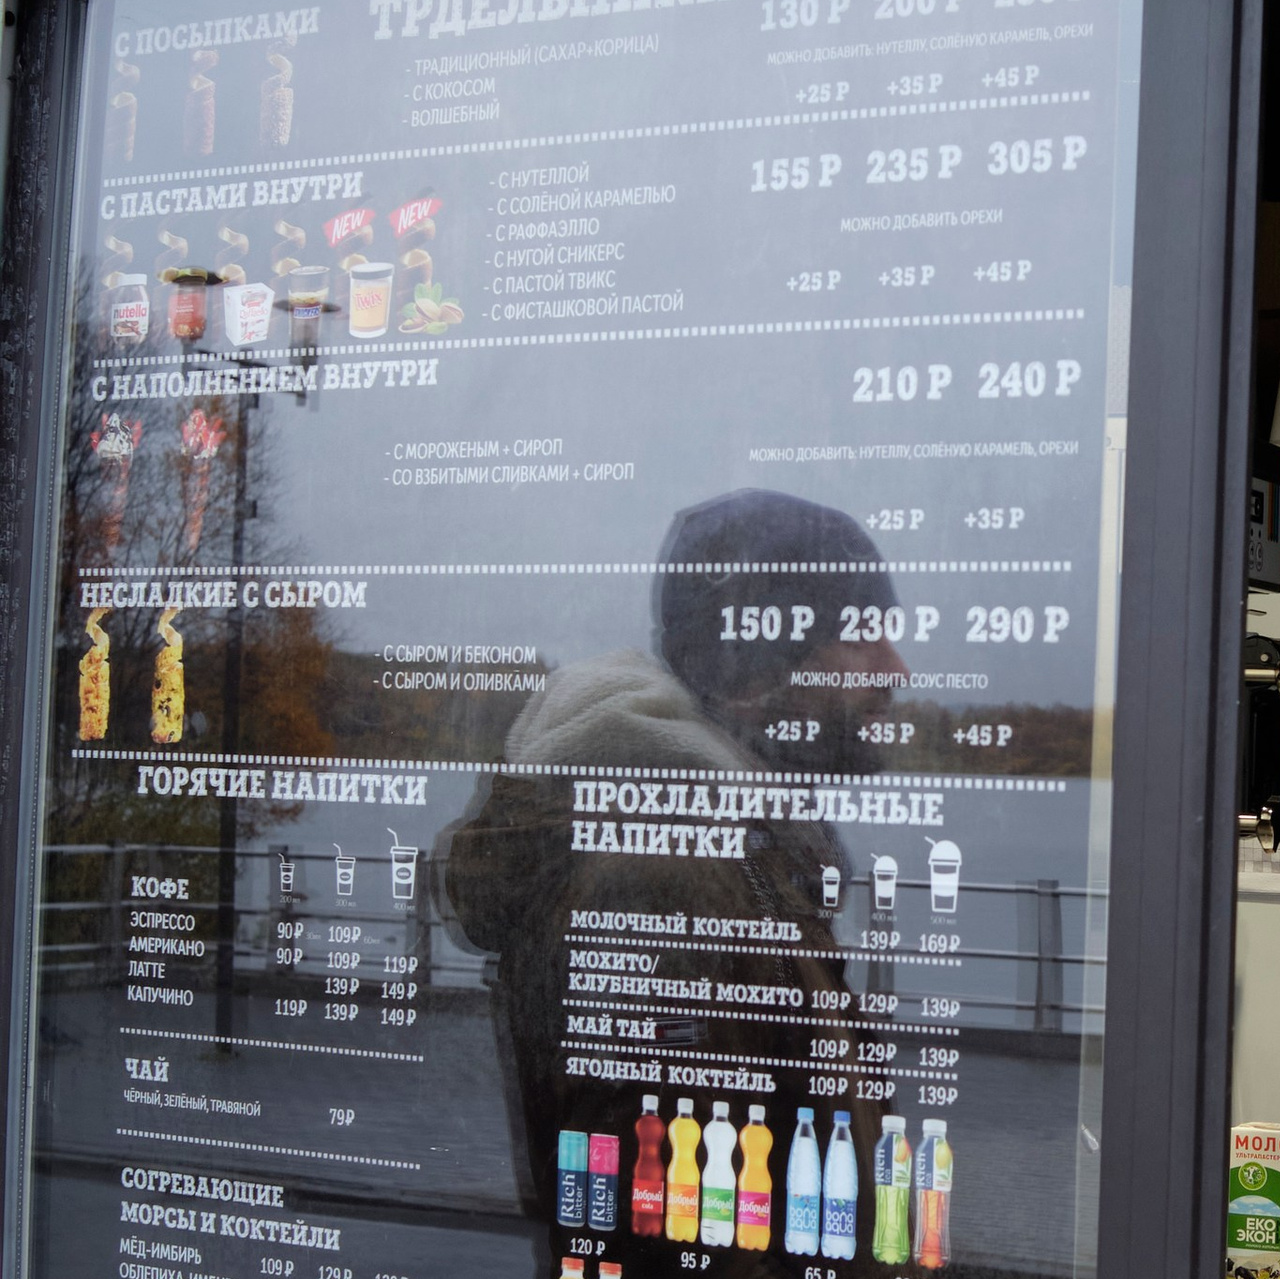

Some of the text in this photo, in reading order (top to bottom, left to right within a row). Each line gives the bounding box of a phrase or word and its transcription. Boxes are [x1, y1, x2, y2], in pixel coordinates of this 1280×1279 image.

[135, 6, 320, 55] ПОСЫПКАМИ
[767, 23, 1094, 65] МОЖНО ДОБАВИТЬ: НУТЕЛЛУ, СОЛЁНУЮ КАРАМЕЛЬ, ОРЕХИ
[415, 34, 659, 76] ТРАДИЦИОННЫЙ (САХАР+КОРИЦА)
[424, 79, 496, 99] КОКОСОМ
[411, 102, 500, 127] ВОЛШЕБНЫЙ
[512, 164, 590, 187] НУТЕЛЛОЙ
[751, 140, 1052, 192] 155 235 305
[119, 179, 248, 216] ПАСТАМИ
[253, 172, 364, 206] ВНУТРИ
[510, 184, 676, 214] СОЛЁНОЙ КАРАМЕЛЬЮ
[331, 209, 365, 244] NEW
[398, 199, 432, 233] NEW
[508, 218, 600, 240] РАФФАЭЛЛО
[840, 208, 1004, 232] МОЖНО ДОБАВИТЬ ОРЕХИ
[506, 243, 624, 268] НУГОЙ СНИКЕРС
[506, 271, 616, 294] ПАСТОЙ ТВИКС
[113, 305, 146, 318] nutella
[504, 292, 684, 320] ФИСТАШКОВОЙ ПАСТОЙ
[110, 362, 318, 399] НАПОЛНЕНИЕМ
[322, 359, 438, 390] ВНУТРИ
[852, 362, 1046, 402] 210 240
[406, 439, 562, 460] МОРОЖЕНЫМ СИРОП
[392, 463, 634, 486] СО ВЗБИТЫМИ СЛИВКАМИ СИРОП
[80, 582, 238, 609] НЕСЛАДКИЕ
[264, 581, 368, 608] СЫРОМ
[720, 606, 1034, 642] 150 230 290
[396, 645, 536, 664] СЫРОМ БЕКОНОМ
[395, 672, 546, 692] СЫРОМ ОЛИВКАМИ
[790, 672, 988, 691] МОЖНО ДОБАВИТЬ СОУС ПЕСТО
[138, 766, 428, 806] ГОРЯЧИЕ НАПИТКИ
[572, 781, 944, 826] ПРОХЛАДИТЕЛЬНЫЕ
[571, 821, 746, 858] НАПИТКИ
[132, 876, 188, 900] КОФЕ
[130, 910, 196, 931] ЭСПРЕССО
[570, 910, 688, 934] МОЛОЧНЫЙ
[692, 916, 802, 942] КОКТЕЙЛЬ
[129, 936, 205, 958] АМЕРИКАНО
[128, 960, 166, 978] ЛАТТЕ
[569, 950, 659, 974] МОХИТО/
[128, 984, 193, 1006] КАПУЧИНО
[568, 972, 712, 1002] КЛУБНИЧНЫЙ
[716, 985, 804, 1008] МОХИТО
[567, 1014, 614, 1036] МАЙ
[616, 1017, 657, 1040] ТАЙ
[124, 1056, 169, 1082] ЧАЙ
[566, 1056, 662, 1082] ЯГОДНЫЙ
[668, 1066, 776, 1092] КОКТЕЙЛЬ
[124, 1088, 163, 1107] ЧЁРНЫЙ,
[164, 1093, 210, 1113] ЗЕЛЁНЫЙ,
[210, 1098, 260, 1116] ТРАВЯНОЙ
[122, 1166, 284, 1208] СОГРЕВАЮЩИЕ
[561, 1174, 575, 1218] Rich
[592, 1178, 606, 1222] Rich
[574, 1186, 583, 1219] bitter
[605, 1190, 614, 1222] bitter
[120, 1200, 196, 1231] МОРСЫ
[220, 1214, 340, 1250] КОКТЕЙЛИ
[120, 1236, 202, 1264] МЁД-ИМБИРЬ
